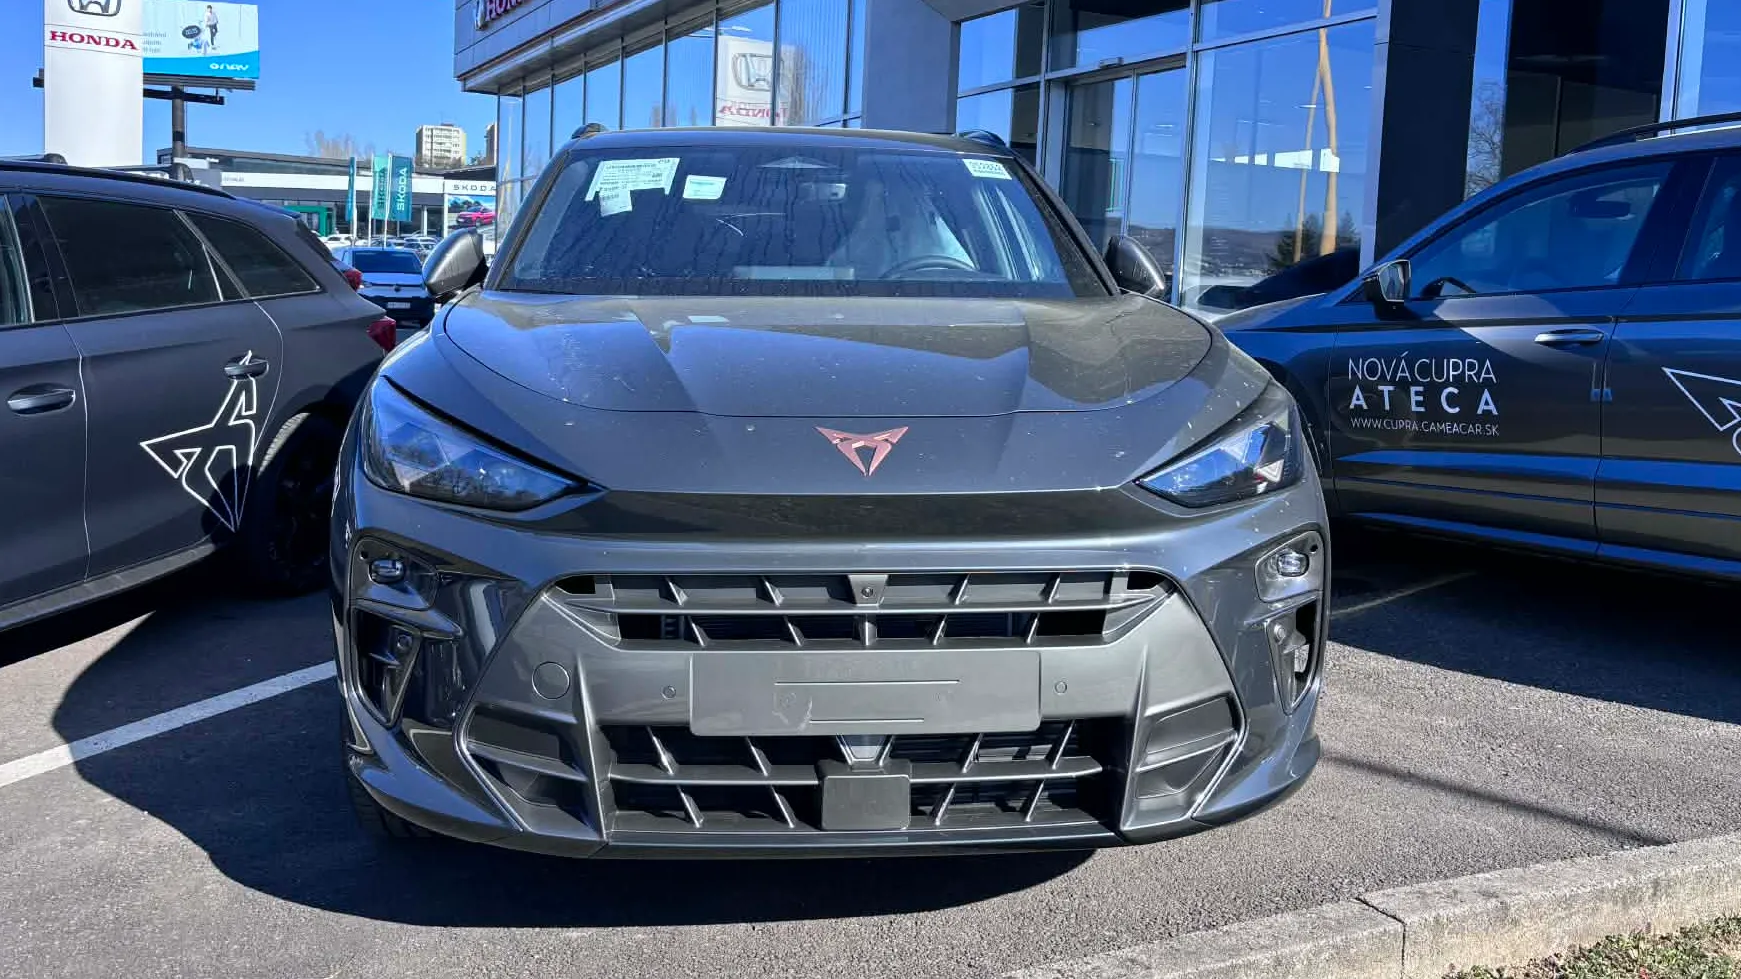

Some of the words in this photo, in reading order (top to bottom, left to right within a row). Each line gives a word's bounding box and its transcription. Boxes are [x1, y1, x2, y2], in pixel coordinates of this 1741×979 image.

[50, 30, 138, 50] HONDA
[1348, 350, 1412, 382] NOVÁ
[1414, 358, 1497, 384] CUPRA
[1349, 384, 1499, 416] ATECA
[1350, 417, 1500, 437] WWW.CUPRA.CAMEACAR.SK
